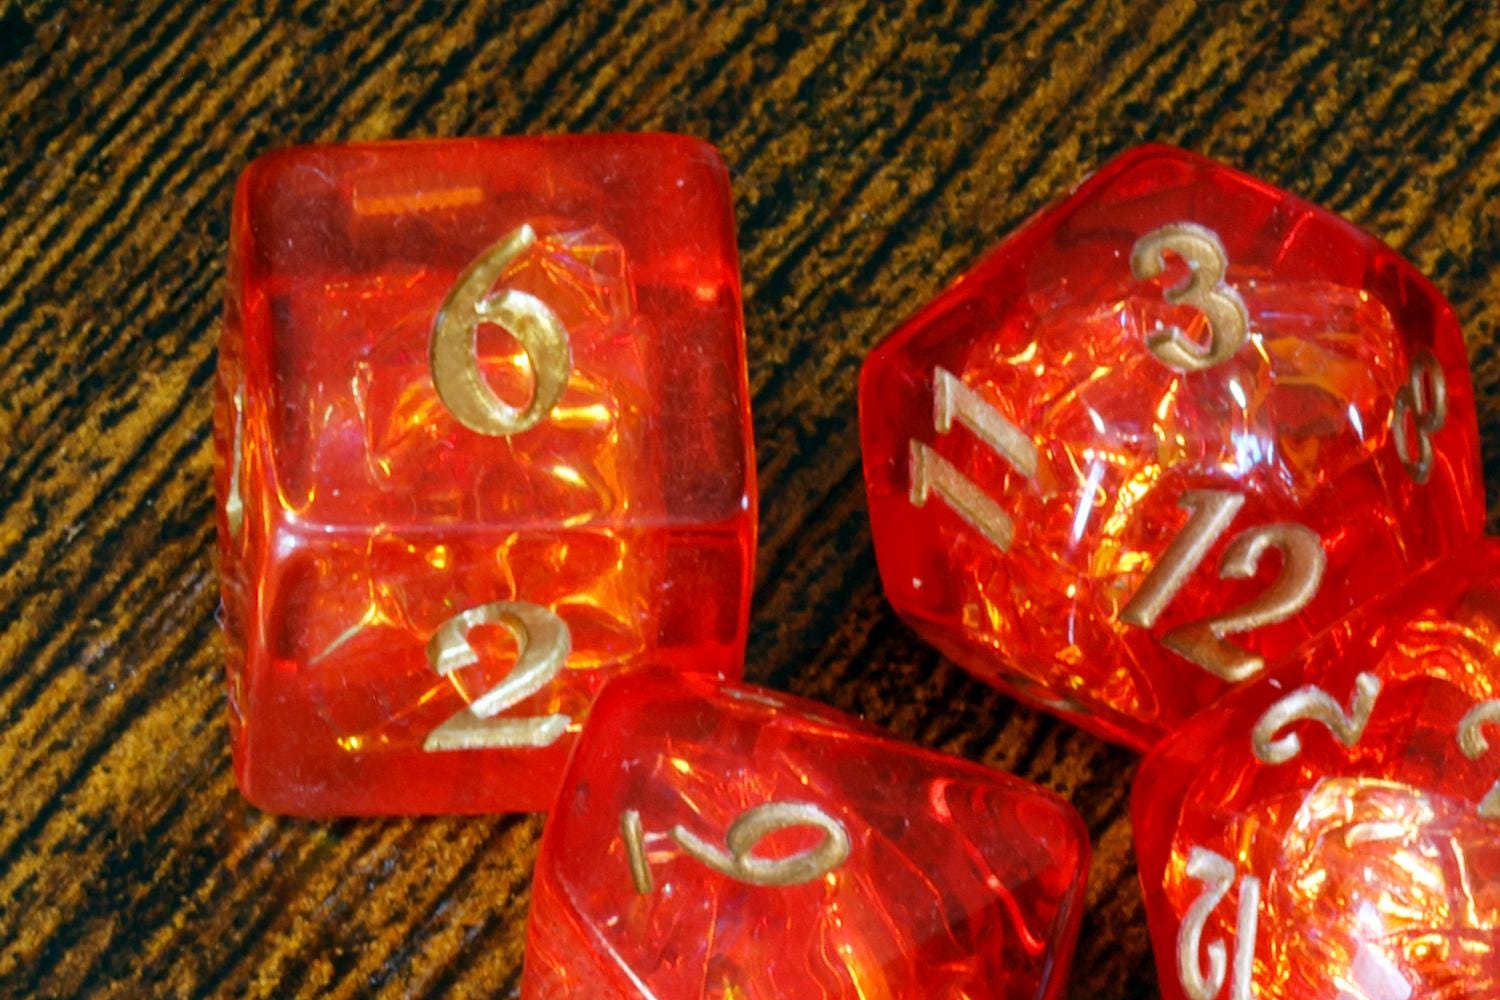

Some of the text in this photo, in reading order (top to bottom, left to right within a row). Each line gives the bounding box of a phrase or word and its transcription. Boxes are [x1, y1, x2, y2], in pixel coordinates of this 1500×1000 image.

[430, 223, 570, 436] 6
[1131, 222, 1248, 371] 3
[909, 366, 1038, 552] 11
[1119, 490, 1326, 681] 12
[423, 601, 571, 752] 2
[1252, 672, 1380, 765] 2
